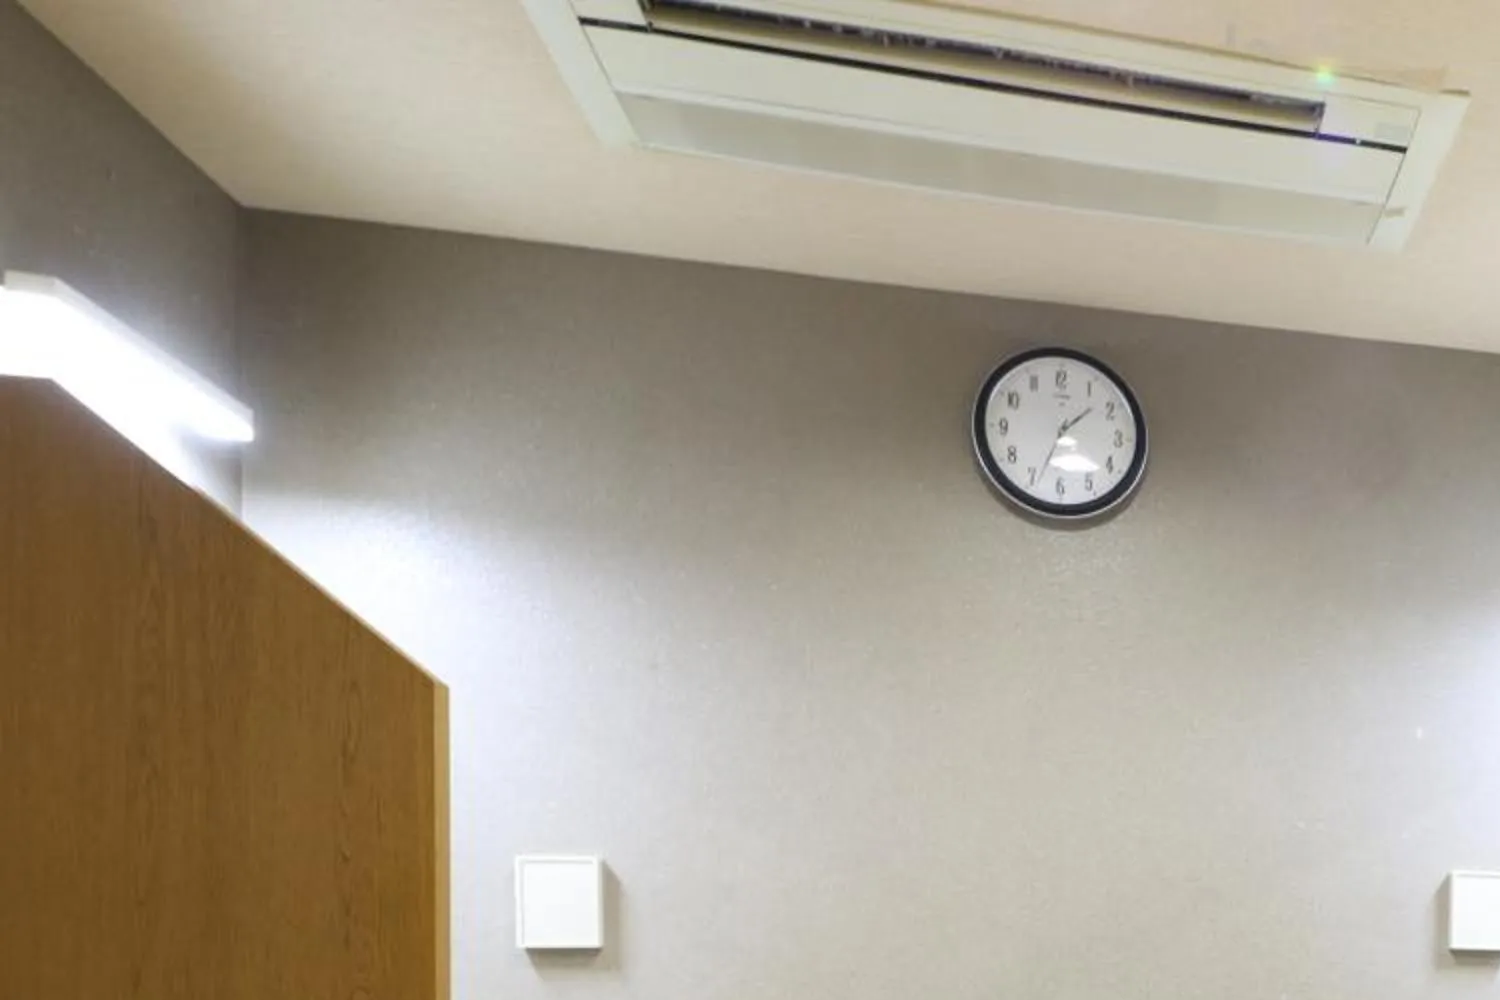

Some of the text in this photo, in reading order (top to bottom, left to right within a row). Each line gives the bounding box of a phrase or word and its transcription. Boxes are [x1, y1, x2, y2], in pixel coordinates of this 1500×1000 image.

[1055, 370, 1068, 390] 12
[1007, 391, 1020, 410] 10
[1105, 401, 1115, 421] 2
[998, 418, 1009, 436] 9
[1113, 430, 1123, 448] 3
[1007, 445, 1017, 464] 8
[1056, 476, 1065, 496] 6
[1084, 474, 1094, 492] 5
